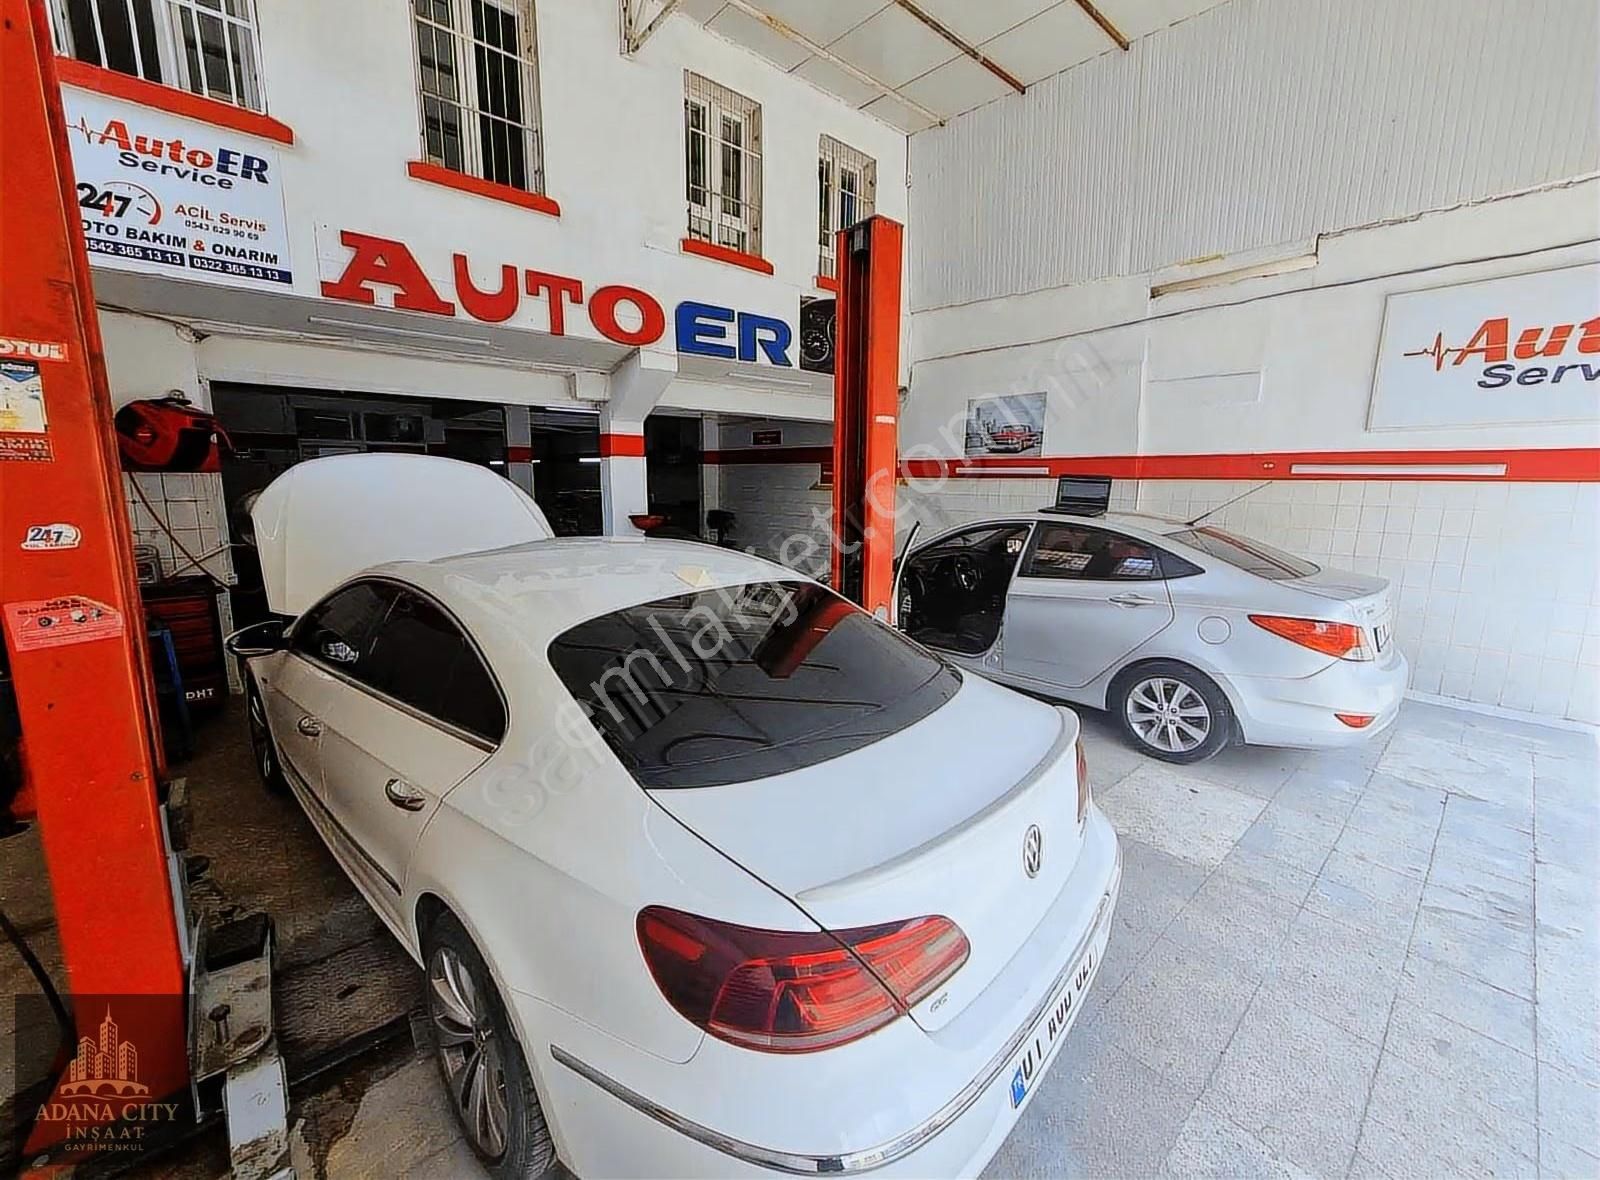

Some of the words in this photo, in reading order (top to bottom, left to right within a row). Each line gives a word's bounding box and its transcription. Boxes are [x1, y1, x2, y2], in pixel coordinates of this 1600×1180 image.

[99, 120, 269, 184] AutoER
[118, 152, 233, 190] Service
[219, 212, 266, 232] Servis
[118, 245, 143, 257] 365
[146, 250, 162, 261] 13
[165, 253, 181, 264] 13
[126, 227, 187, 249] BAKIM
[193, 240, 205, 252] &
[212, 243, 278, 265] ONARIM
[194, 258, 223, 270] 0322
[225, 263, 247, 274] 365
[249, 267, 264, 277] 13
[266, 270, 280, 280] 13
